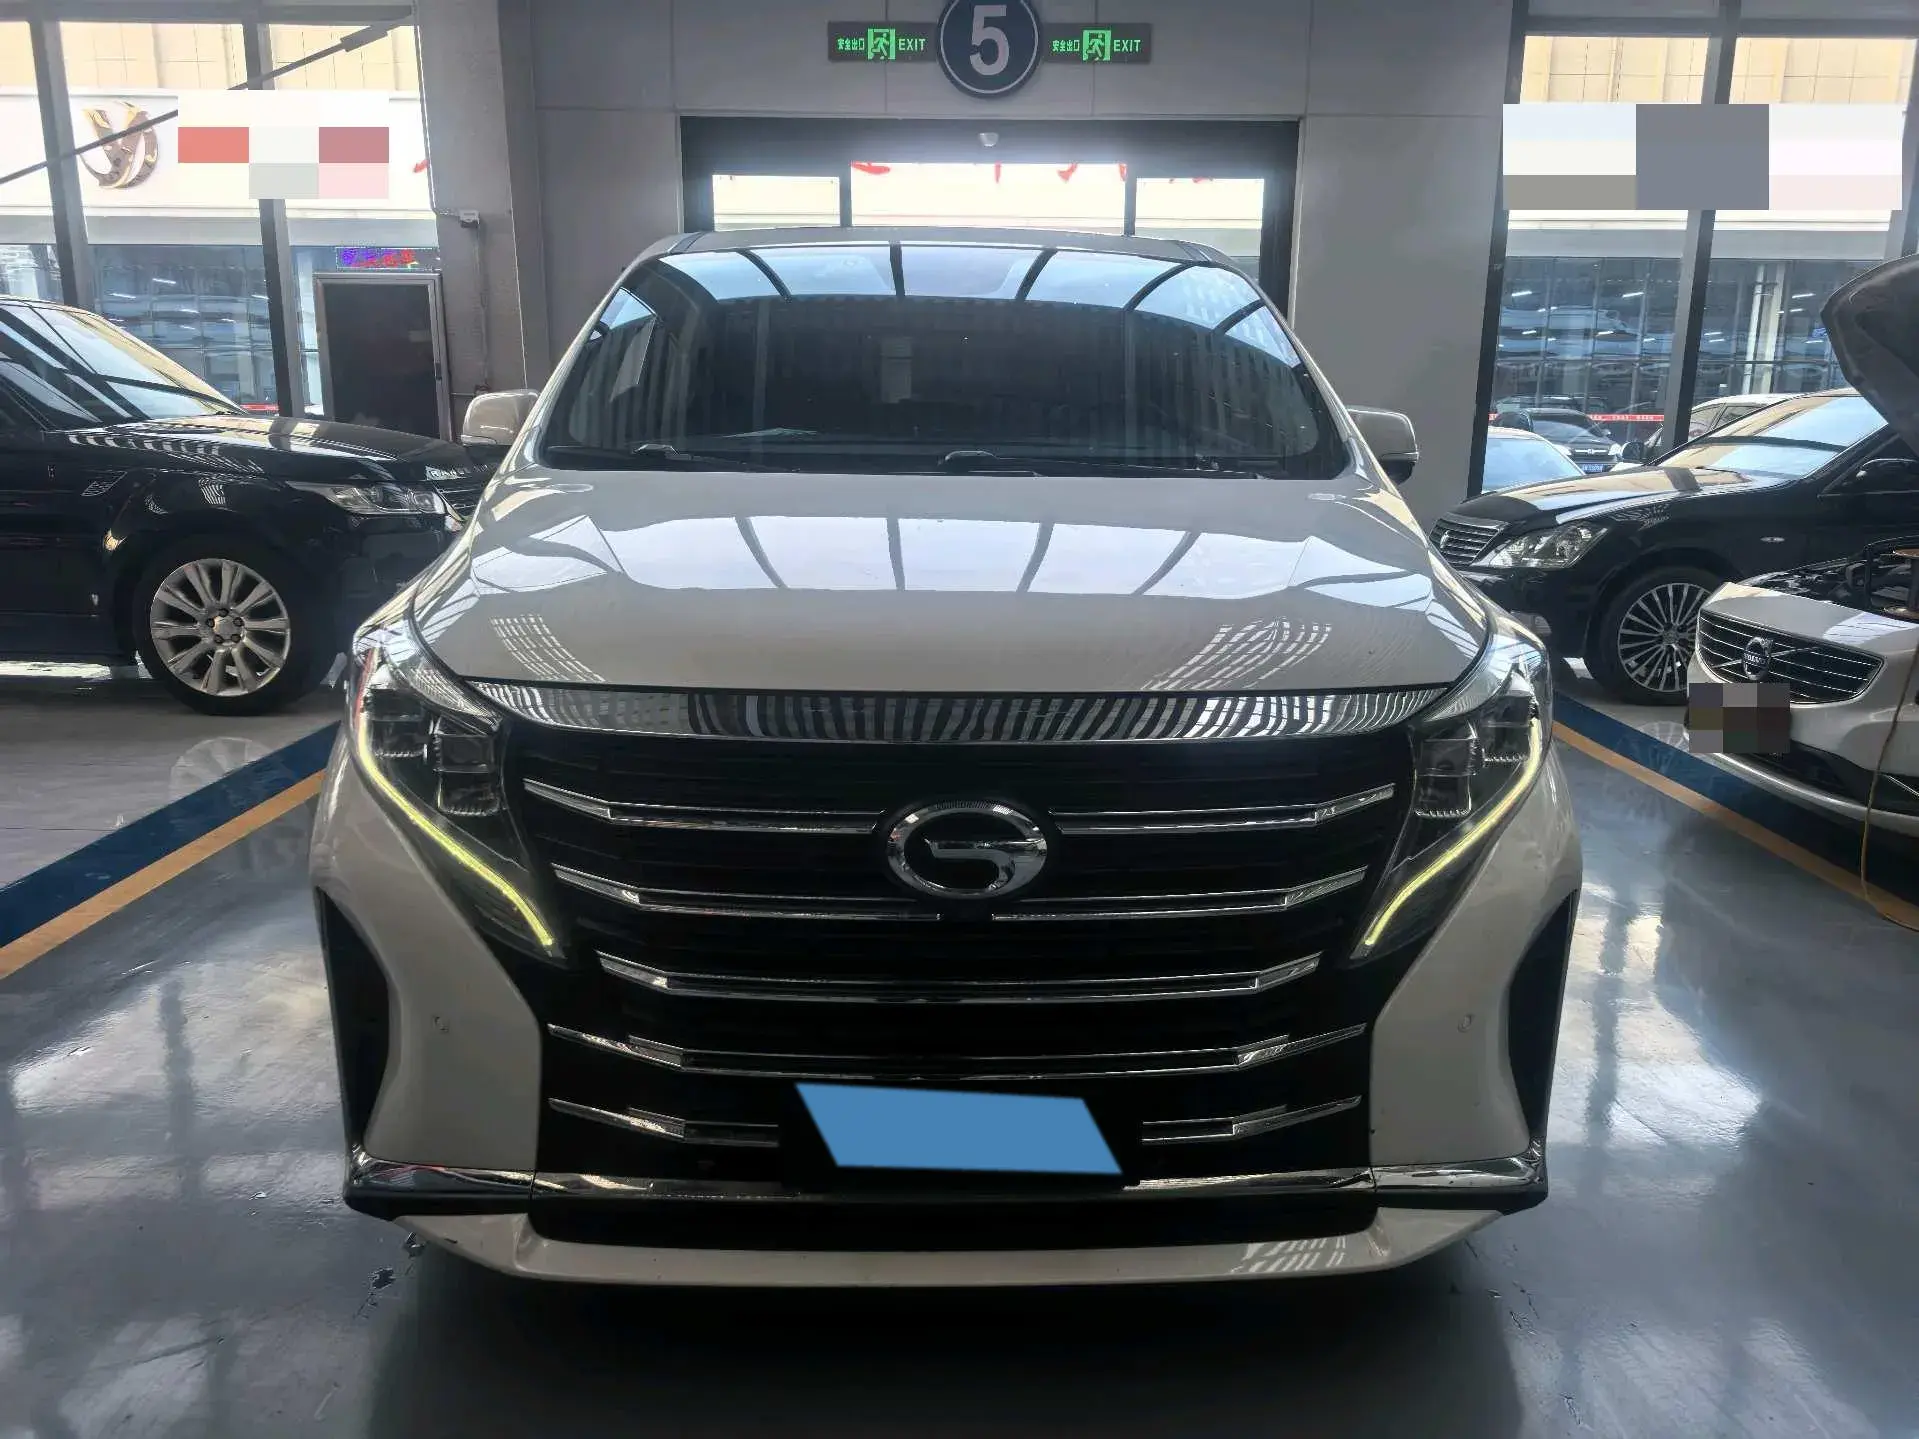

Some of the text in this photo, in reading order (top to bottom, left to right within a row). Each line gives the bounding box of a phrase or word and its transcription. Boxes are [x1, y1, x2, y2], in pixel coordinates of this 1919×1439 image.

[837, 37, 865, 51] 安全出口
[898, 38, 926, 52] EXIT
[969, 3, 1010, 76] 5
[1052, 39, 1080, 52] 安全出口
[1113, 39, 1141, 53] EXIT
